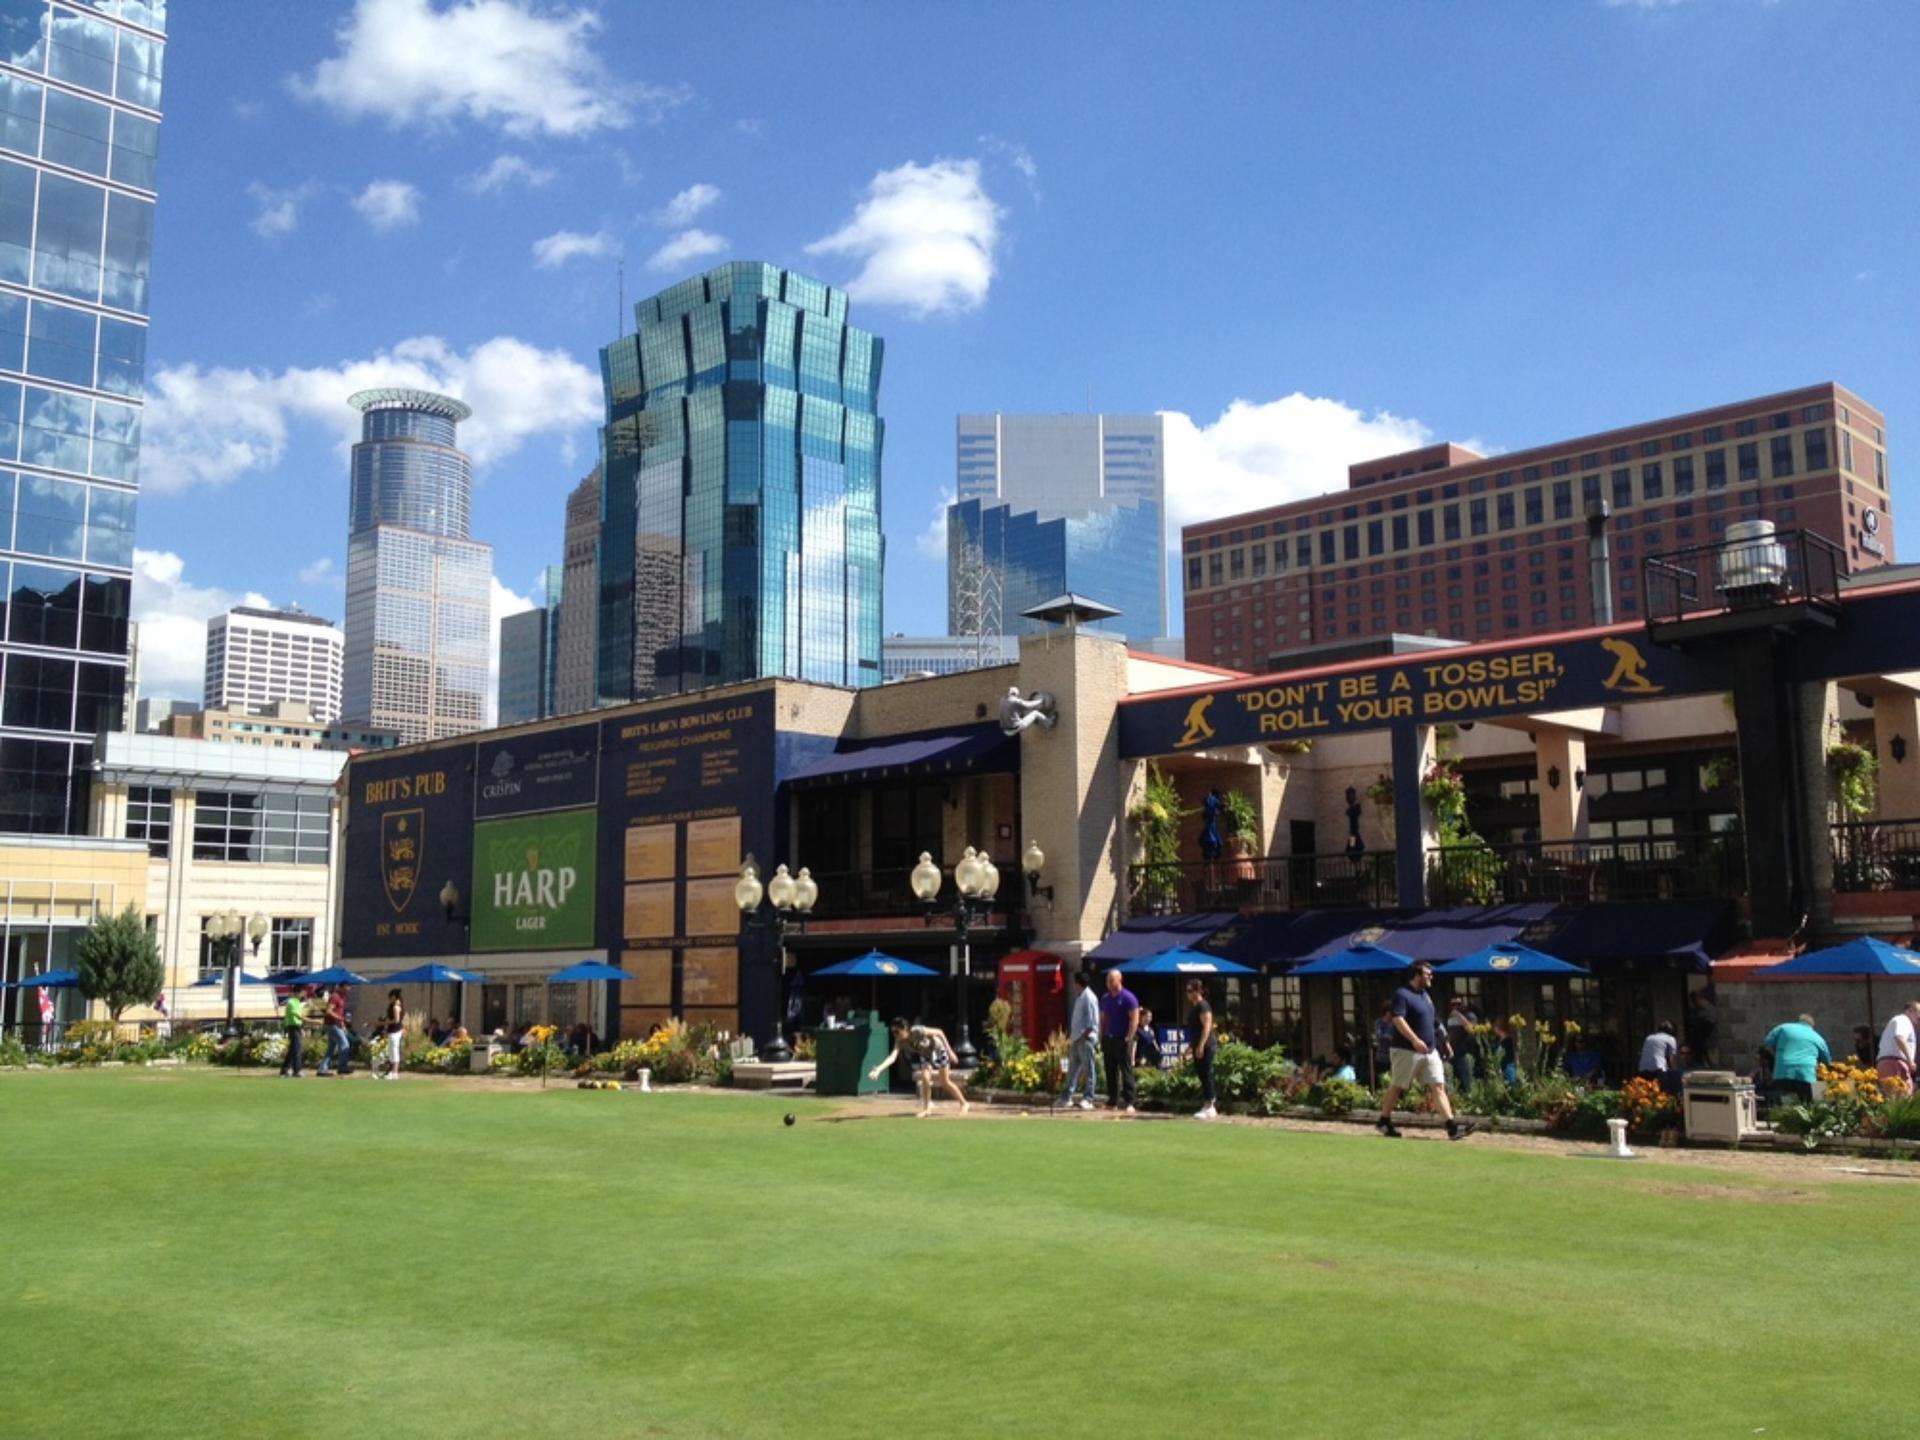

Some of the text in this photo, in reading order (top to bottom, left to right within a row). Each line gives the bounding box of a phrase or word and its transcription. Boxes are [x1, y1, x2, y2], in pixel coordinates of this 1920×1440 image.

[1339, 675, 1378, 698] BE
[1390, 671, 1411, 692] A
[1423, 651, 1565, 688] TOSSER,
[680, 711, 724, 729] BOWLING
[726, 705, 753, 720] CLUB
[1260, 707, 1330, 733] ROLL
[1336, 696, 1413, 724] YOUR
[365, 770, 446, 804] BRIT'S PUB
[494, 866, 576, 909] HARP
[516, 916, 546, 931] LAGER
